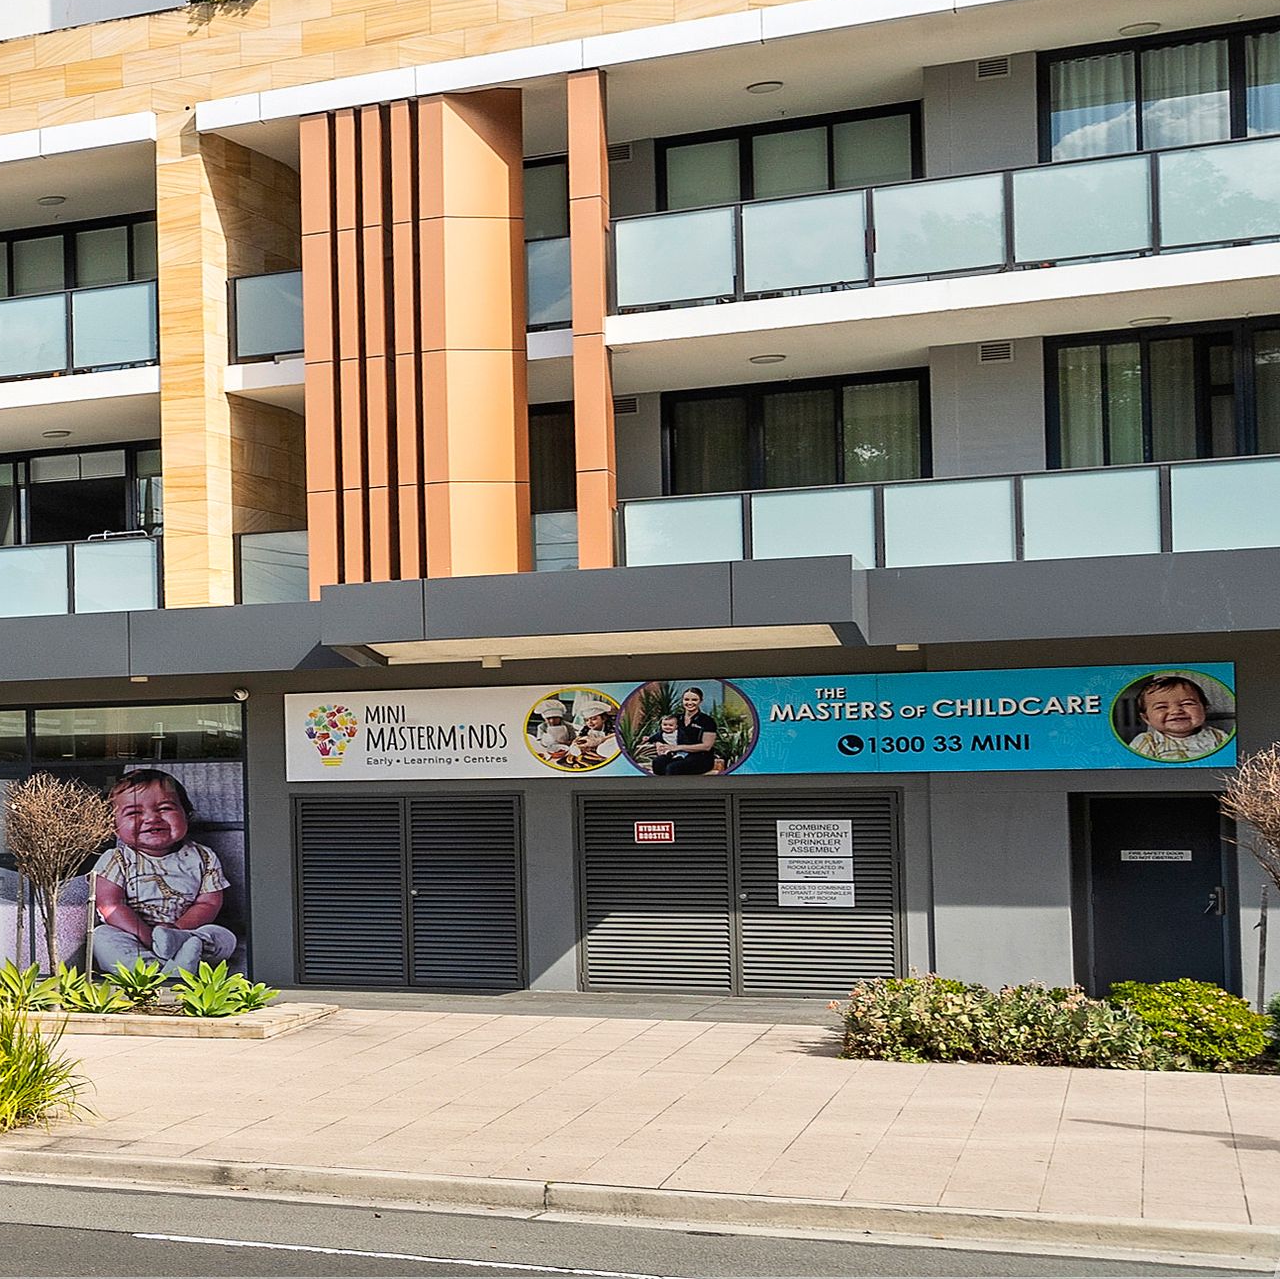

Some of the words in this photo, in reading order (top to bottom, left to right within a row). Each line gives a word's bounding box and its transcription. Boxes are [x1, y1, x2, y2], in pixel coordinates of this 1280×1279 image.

[815, 687, 846, 700] THE
[365, 705, 406, 724] MINI
[769, 701, 893, 721] MASTERS
[899, 705, 927, 718] OF
[932, 695, 1102, 719] CHILDCARE
[867, 735, 925, 754] 1300
[932, 735, 963, 753] 33
[970, 734, 1031, 752] MINI
[366, 757, 393, 767] Early
[403, 756, 452, 765] Learning
[463, 755, 508, 764] Centres
[788, 823, 840, 831] COMBINED
